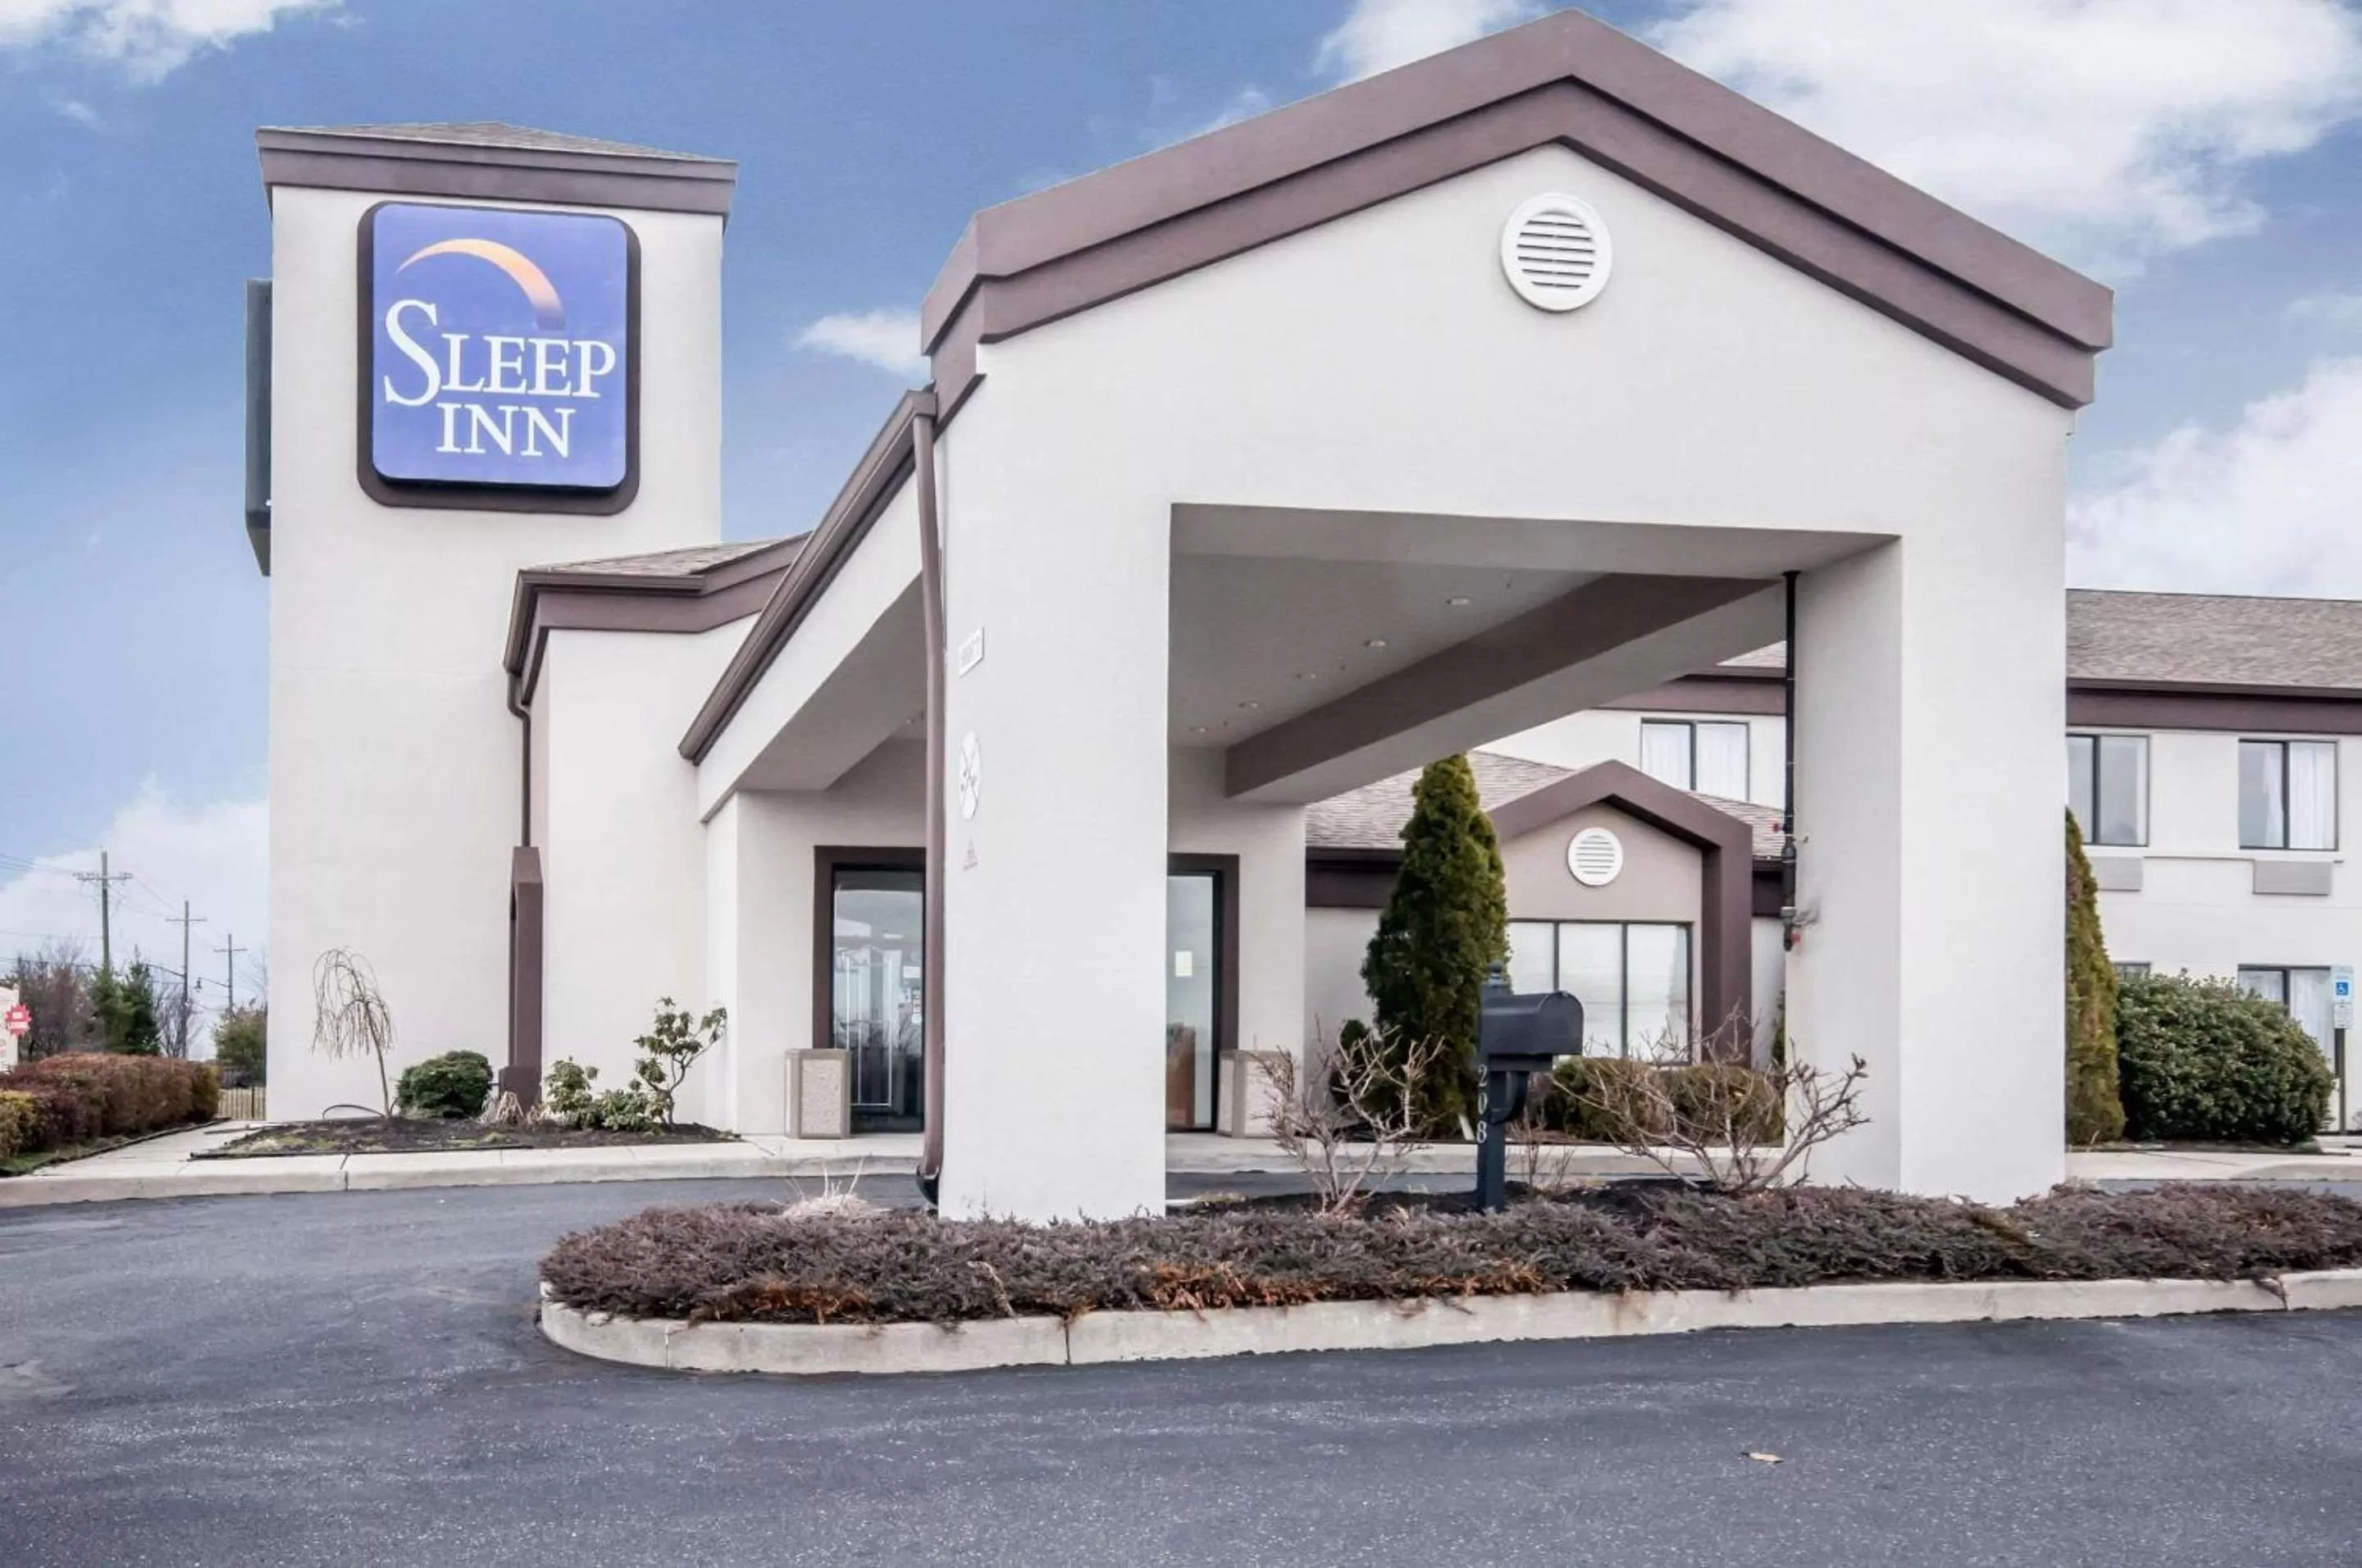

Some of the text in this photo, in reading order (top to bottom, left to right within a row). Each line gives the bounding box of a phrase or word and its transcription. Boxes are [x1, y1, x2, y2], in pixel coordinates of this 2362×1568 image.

[383, 299, 617, 407] SLEEP
[435, 402, 577, 458] INN
[1476, 1064, 1489, 1144] 208
